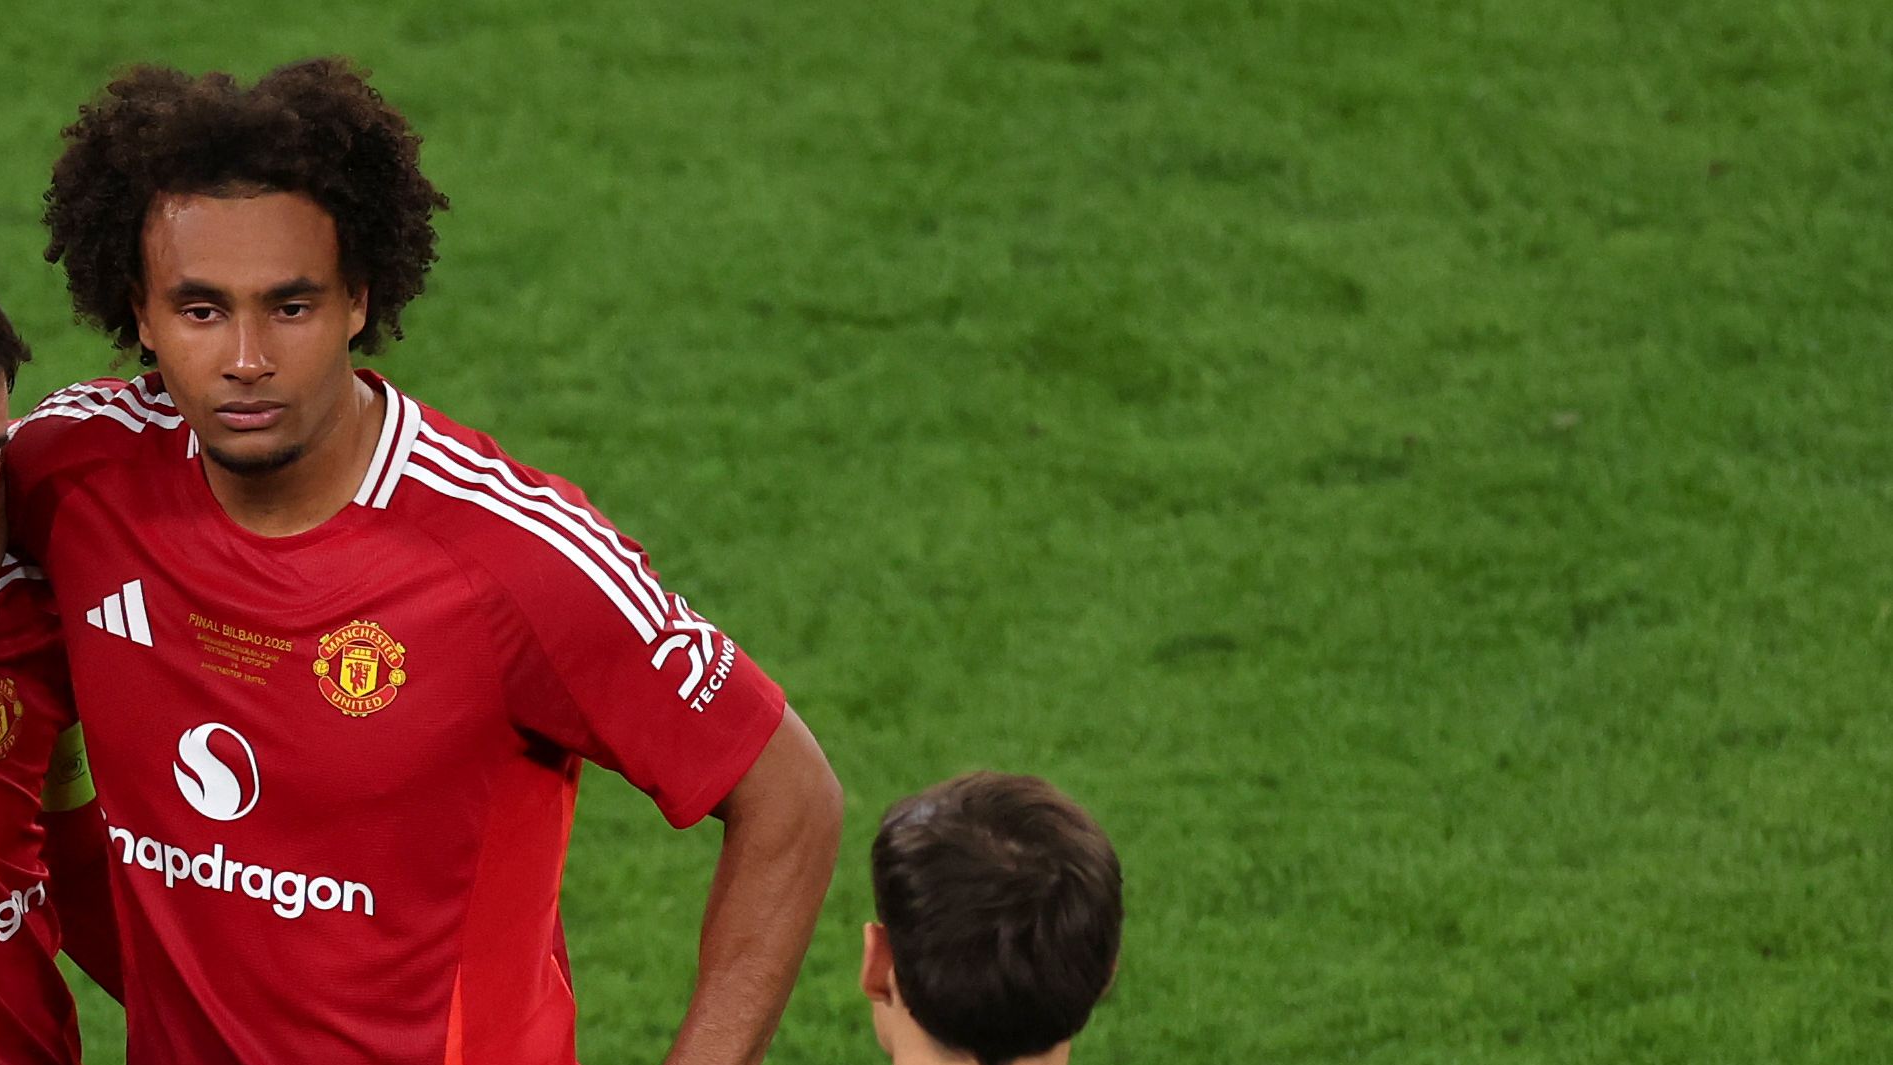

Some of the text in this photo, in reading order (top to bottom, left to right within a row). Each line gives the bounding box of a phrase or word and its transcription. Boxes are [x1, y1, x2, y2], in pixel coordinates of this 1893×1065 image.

[188, 612, 220, 633] FINAL
[222, 624, 263, 646] BILBAO
[264, 635, 293, 653] 2025
[325, 627, 398, 663] MANCHESTER
[651, 594, 718, 701] DX
[331, 690, 383, 711] UNITED
[690, 635, 736, 713] TECHNO
[101, 807, 375, 920] napdragon
